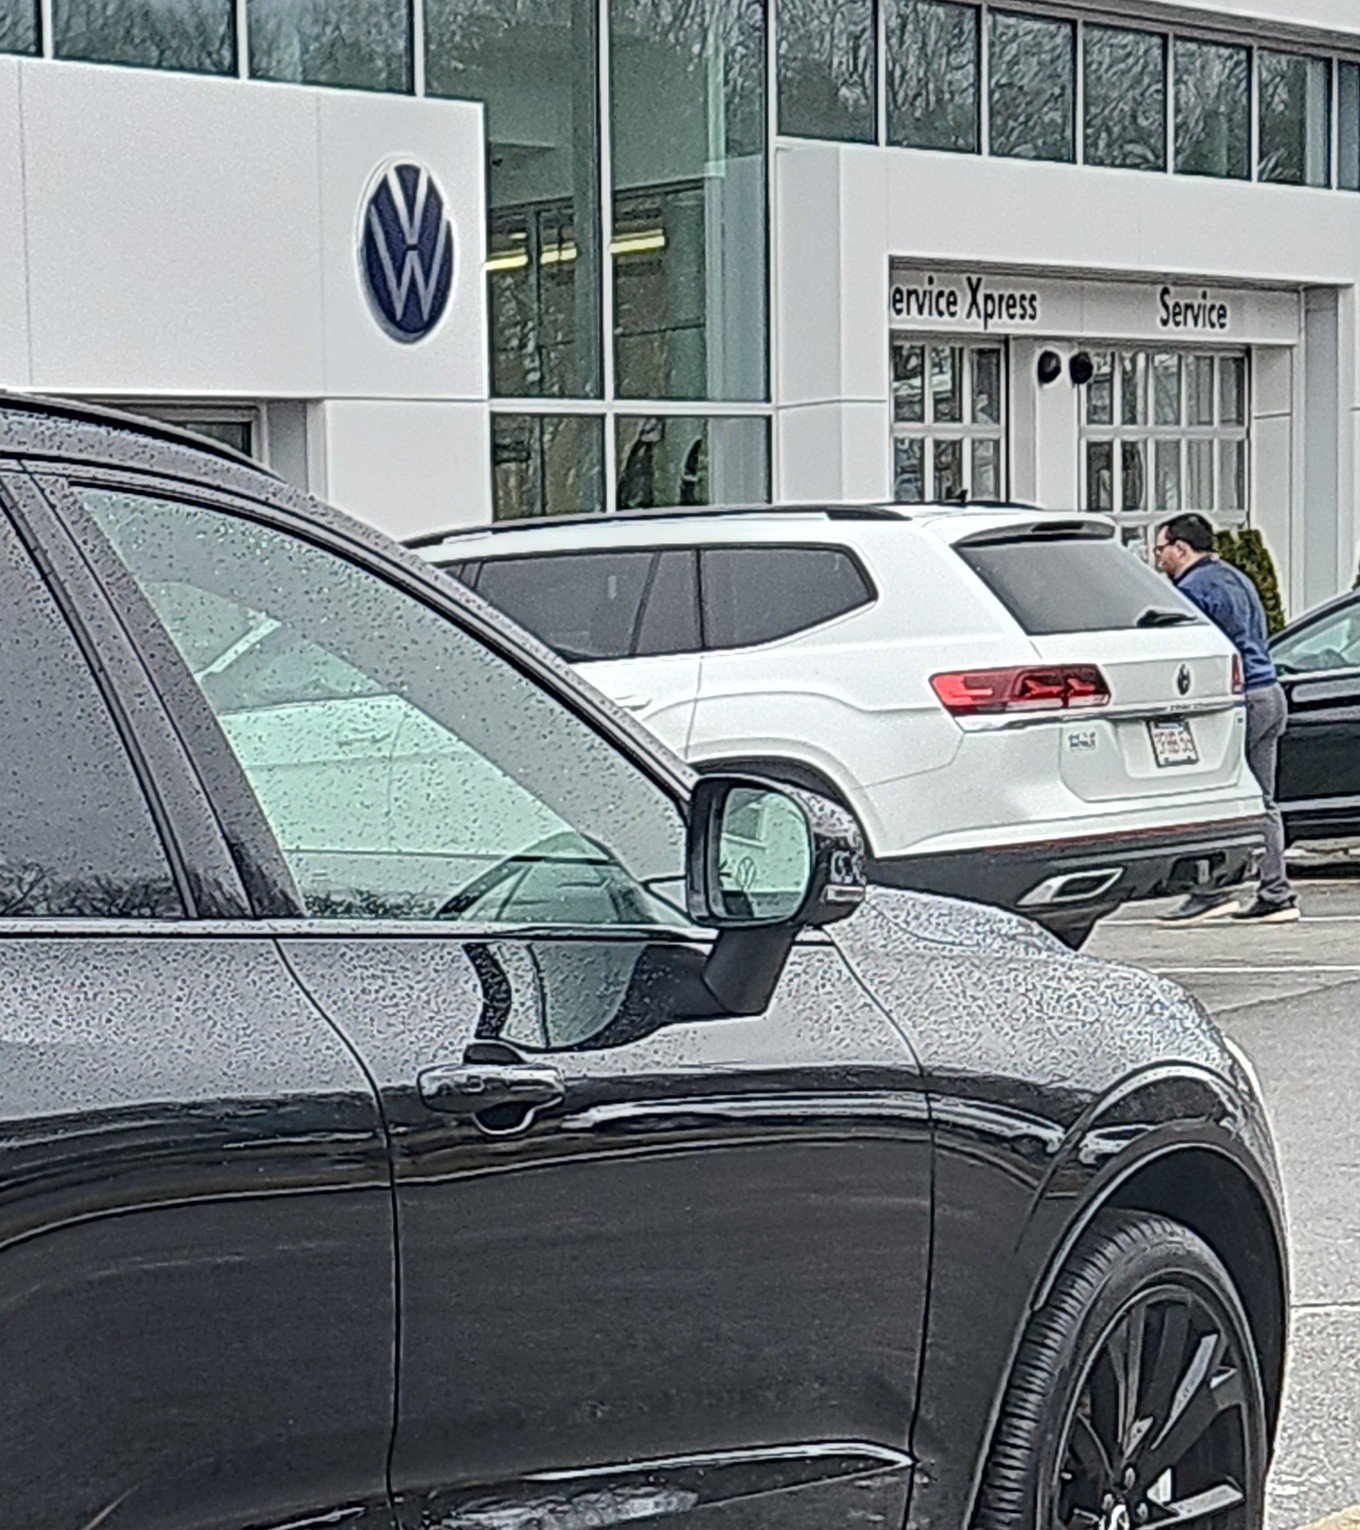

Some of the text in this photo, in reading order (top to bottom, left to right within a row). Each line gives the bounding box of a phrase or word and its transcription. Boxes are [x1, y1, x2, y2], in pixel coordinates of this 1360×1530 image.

[891, 276, 1039, 329] ervice Xpress
[1159, 286, 1228, 329] Service
